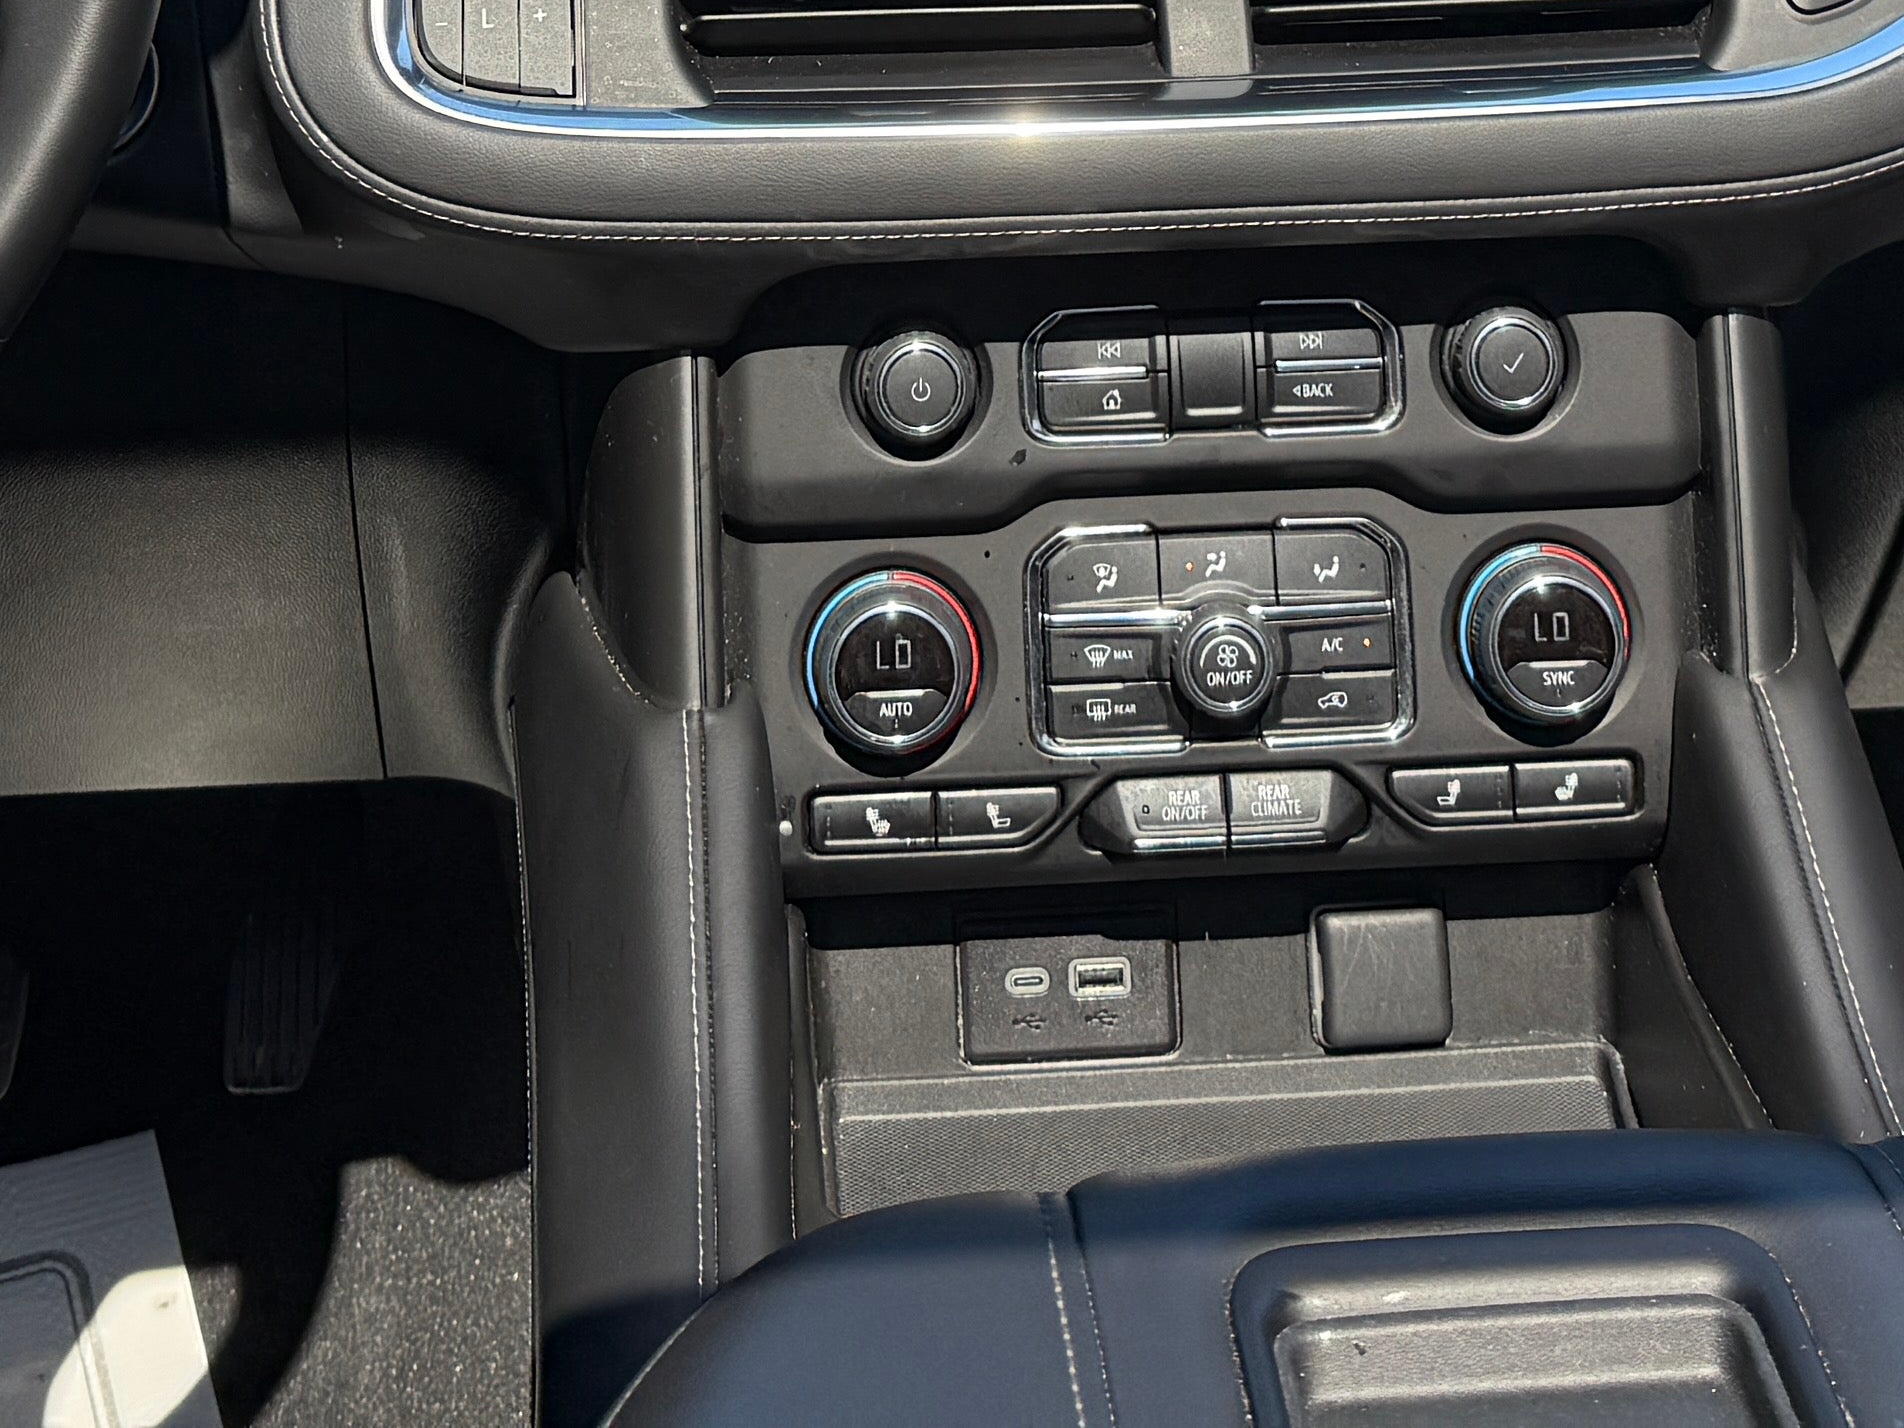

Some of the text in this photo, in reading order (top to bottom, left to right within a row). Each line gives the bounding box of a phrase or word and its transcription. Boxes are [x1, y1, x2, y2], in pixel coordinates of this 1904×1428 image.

[481, 8, 494, 29] L
[1301, 381, 1334, 399] BACK
[1112, 648, 1134, 662] MAX
[1320, 635, 1344, 655] A/C
[1205, 667, 1255, 689] ON/OFF
[1542, 669, 1576, 689] SYNC
[878, 700, 913, 720] AUTO
[1112, 702, 1136, 715] REAR
[1166, 788, 1200, 807] REAR
[1257, 783, 1291, 803] REAR
[1161, 799, 1209, 824] ON/OFF
[1250, 796, 1302, 820] CLIMATE
